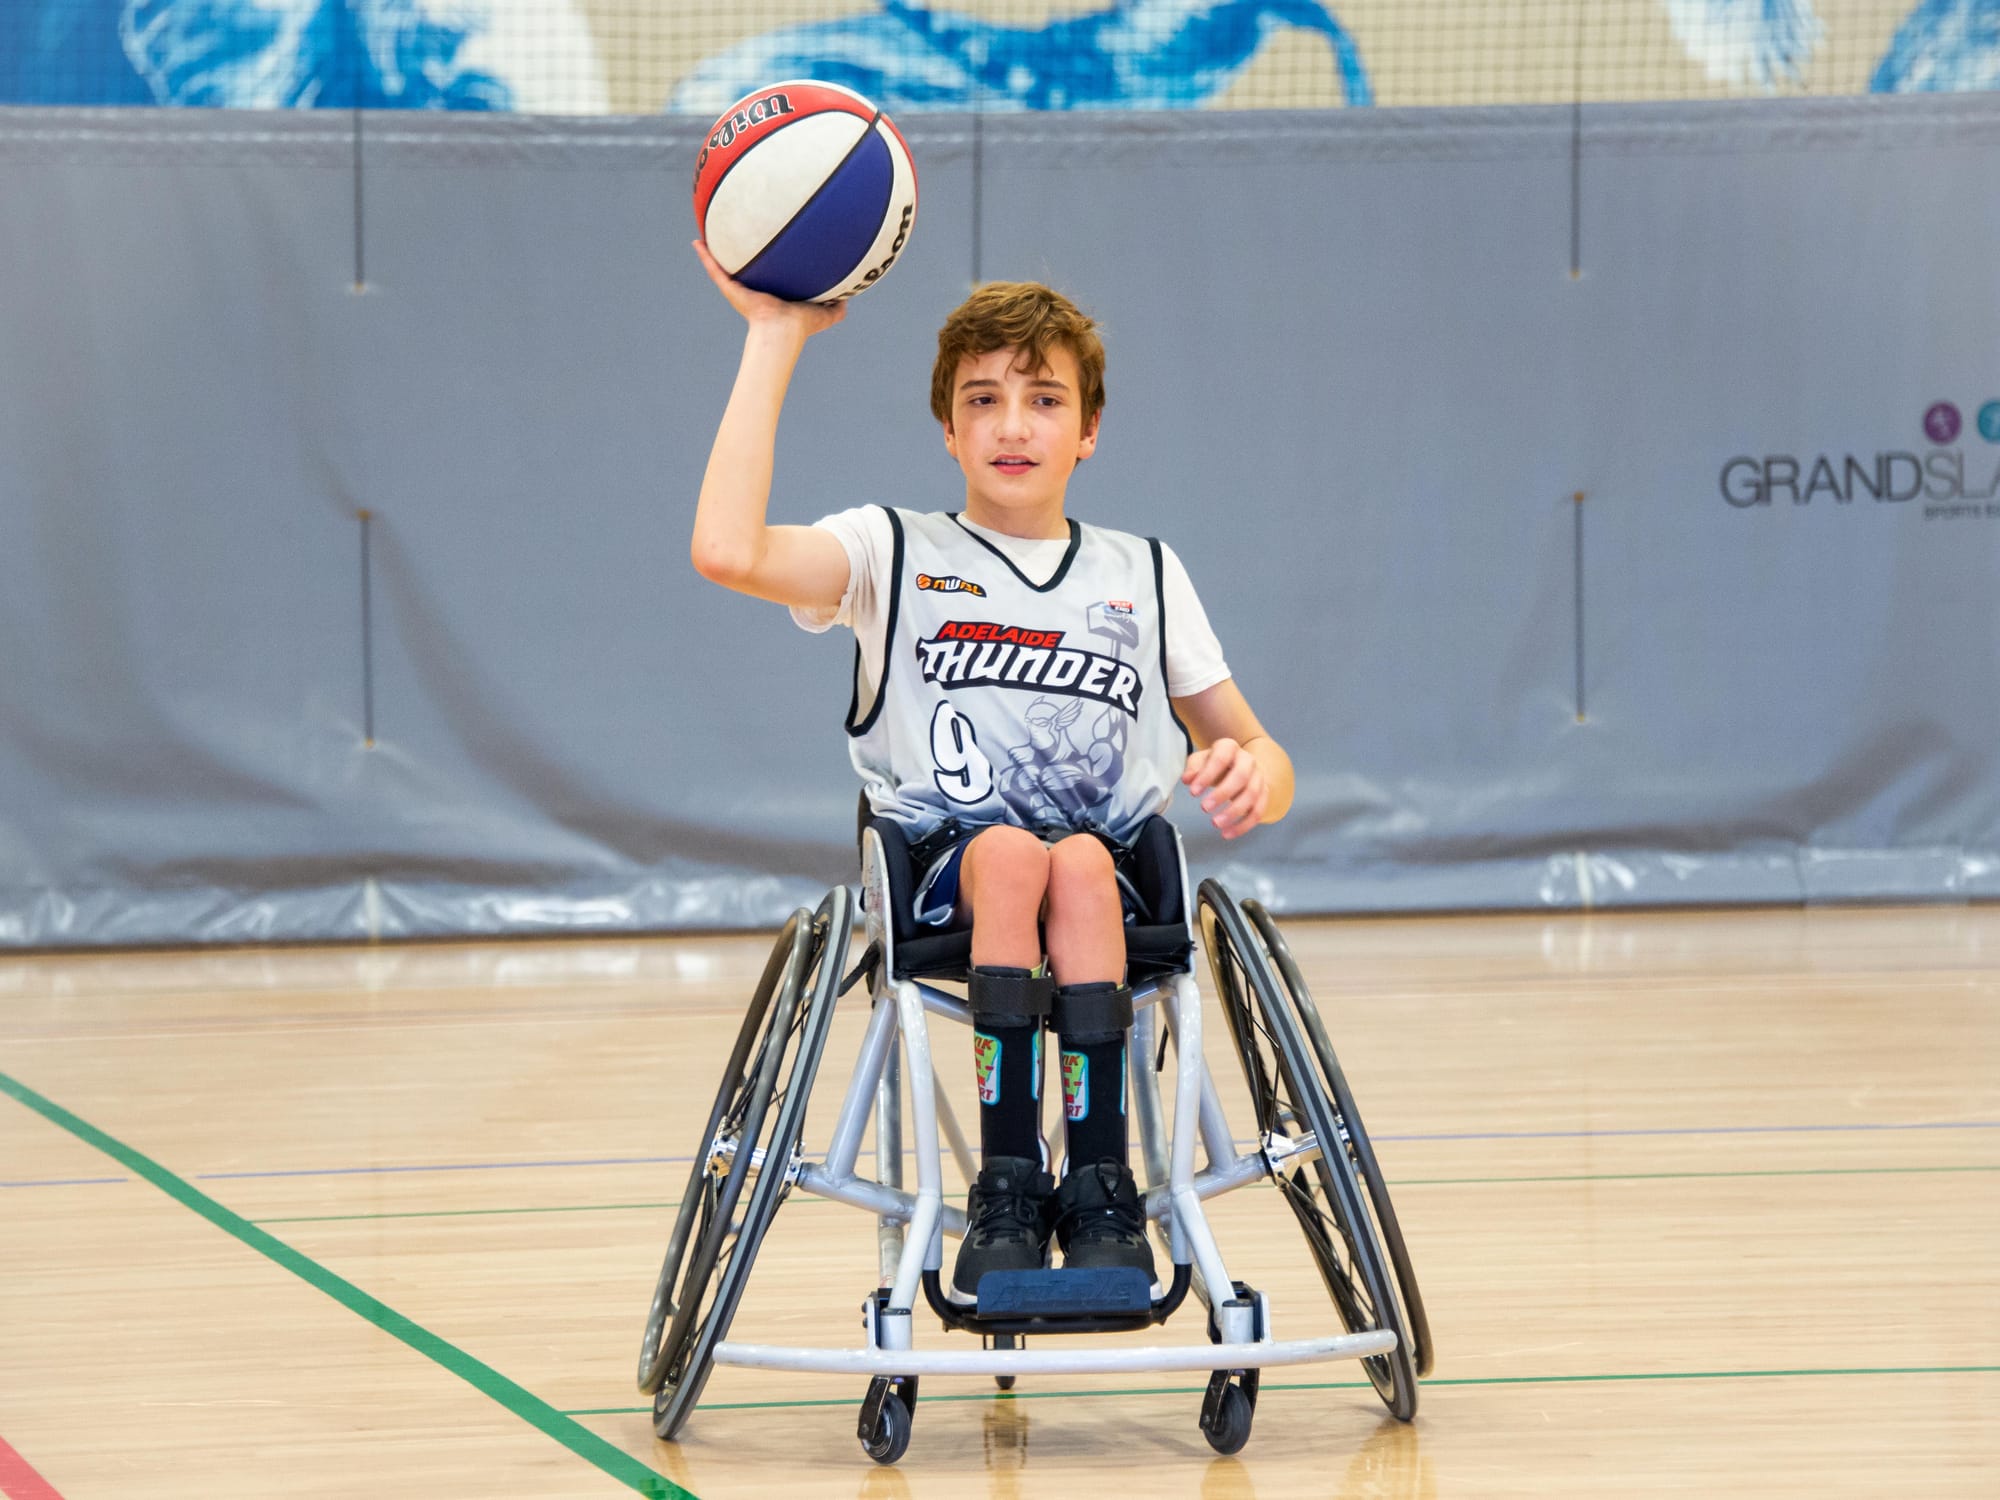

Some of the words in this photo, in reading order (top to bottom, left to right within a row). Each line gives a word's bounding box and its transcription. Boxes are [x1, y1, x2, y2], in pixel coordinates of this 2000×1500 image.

[938, 623, 1061, 648] ADELAIDE
[918, 640, 1138, 712] THUNDER
[930, 700, 994, 804] 9
